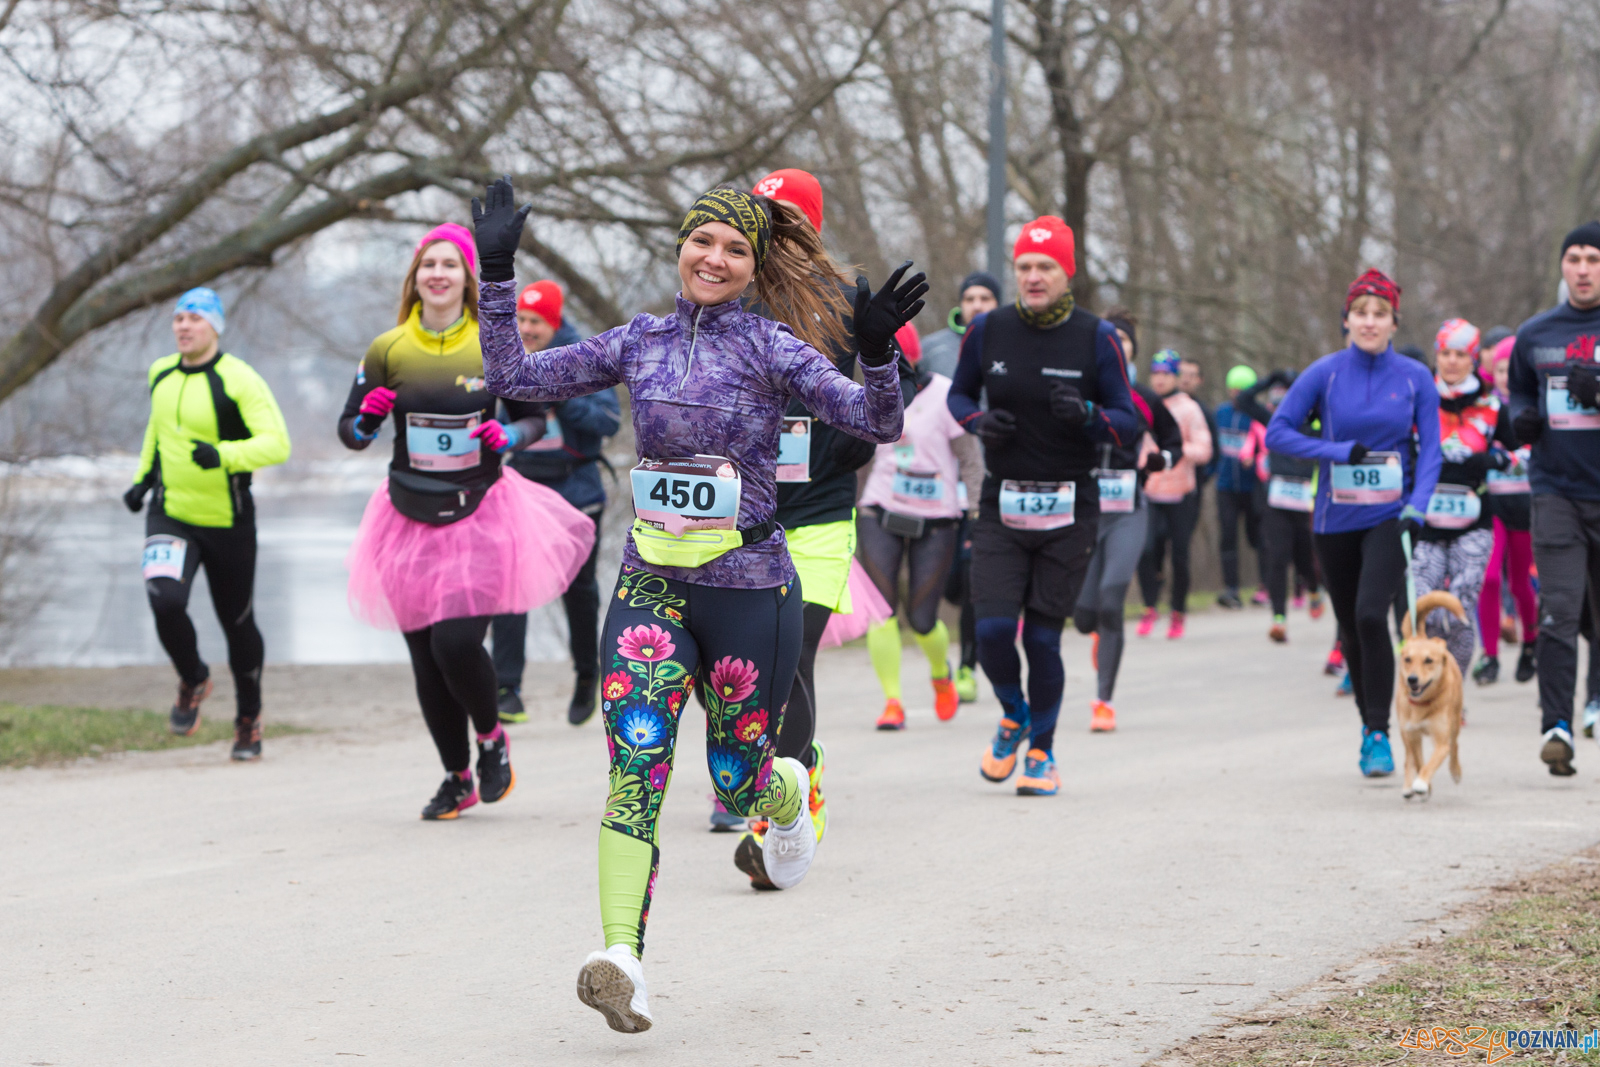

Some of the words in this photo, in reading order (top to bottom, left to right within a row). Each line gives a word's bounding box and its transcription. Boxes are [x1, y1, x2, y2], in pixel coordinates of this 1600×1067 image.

[438, 433, 453, 451] 9
[1353, 469, 1381, 486] 98
[650, 478, 716, 511] 450
[1016, 496, 1059, 513] 137
